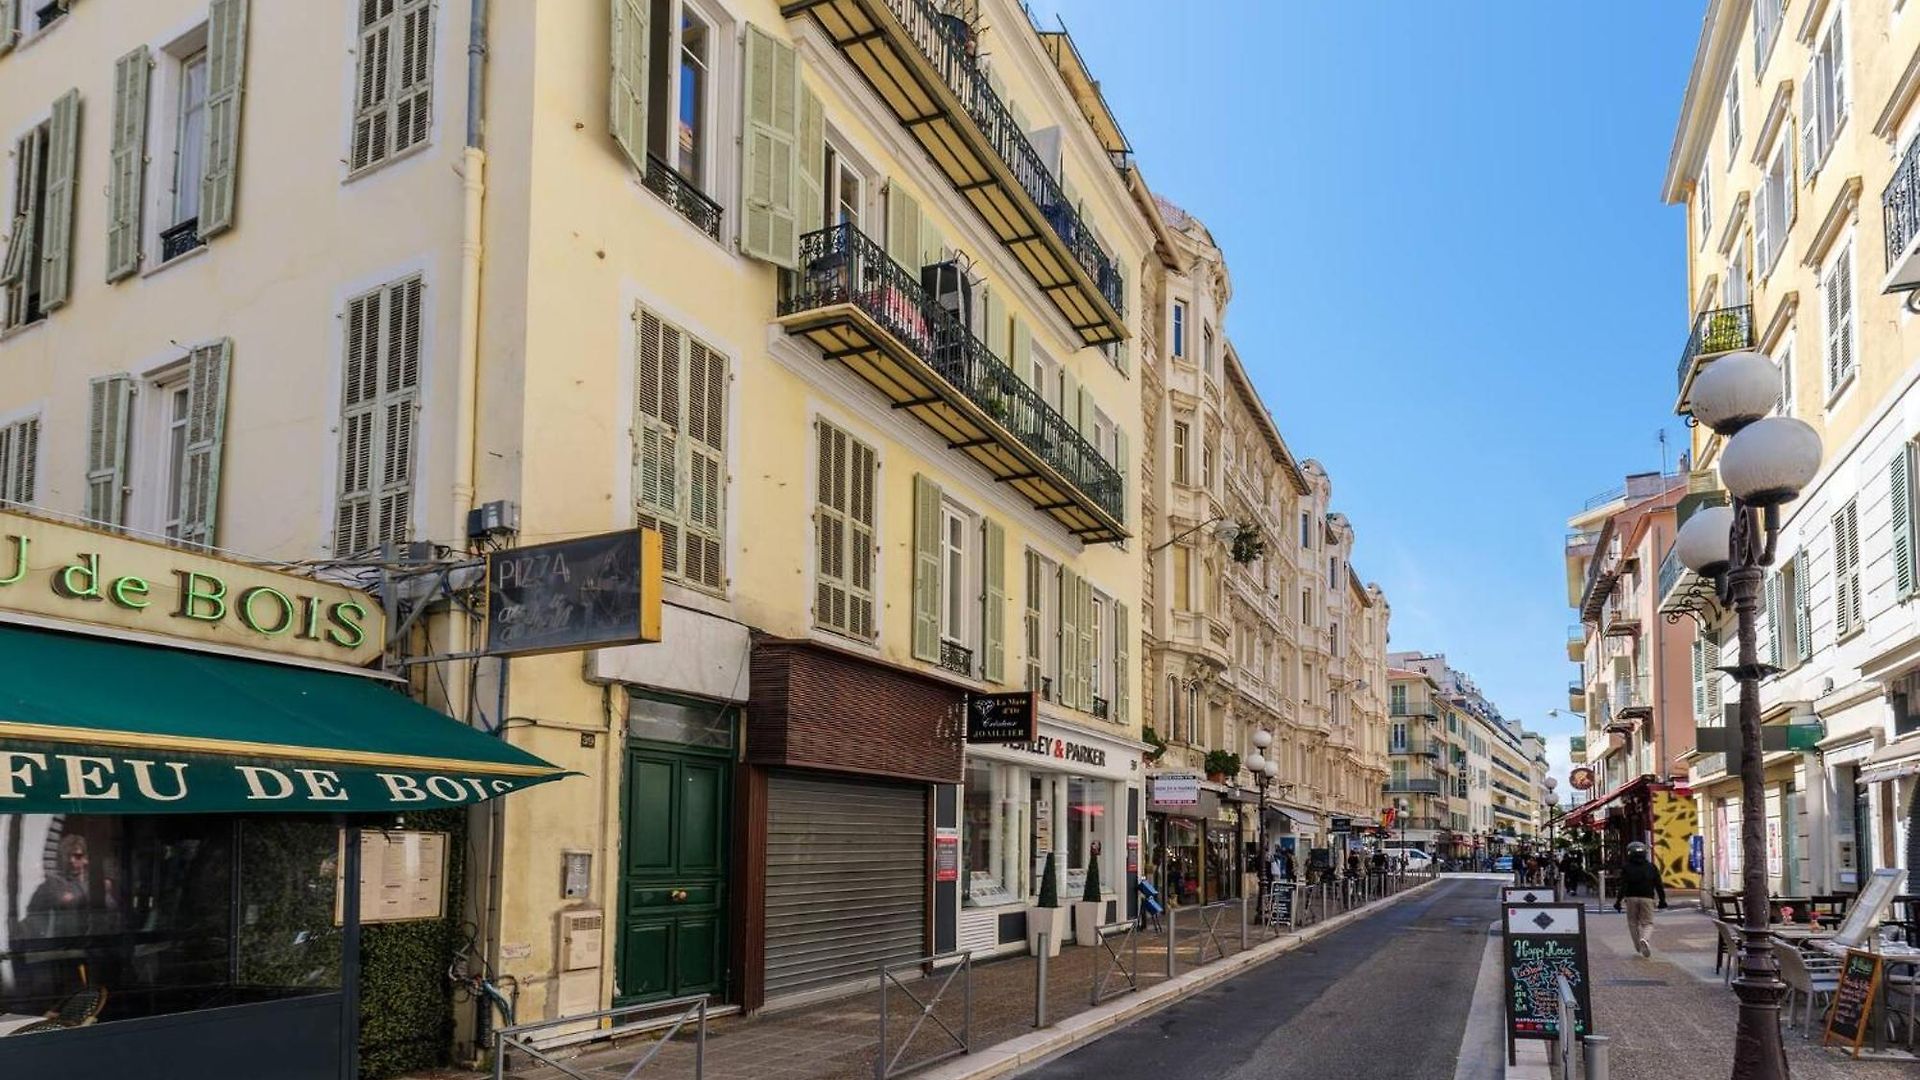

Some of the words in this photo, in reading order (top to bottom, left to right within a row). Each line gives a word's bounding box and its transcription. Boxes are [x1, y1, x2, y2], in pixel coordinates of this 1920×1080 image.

[51, 552, 150, 614] de
[170, 568, 366, 648] BOIS
[1054, 739, 1064, 759] &
[1065, 741, 1106, 767] PARKER
[0, 751, 189, 801] FEU
[235, 766, 349, 800] DE
[1514, 940, 1544, 960] Happy
